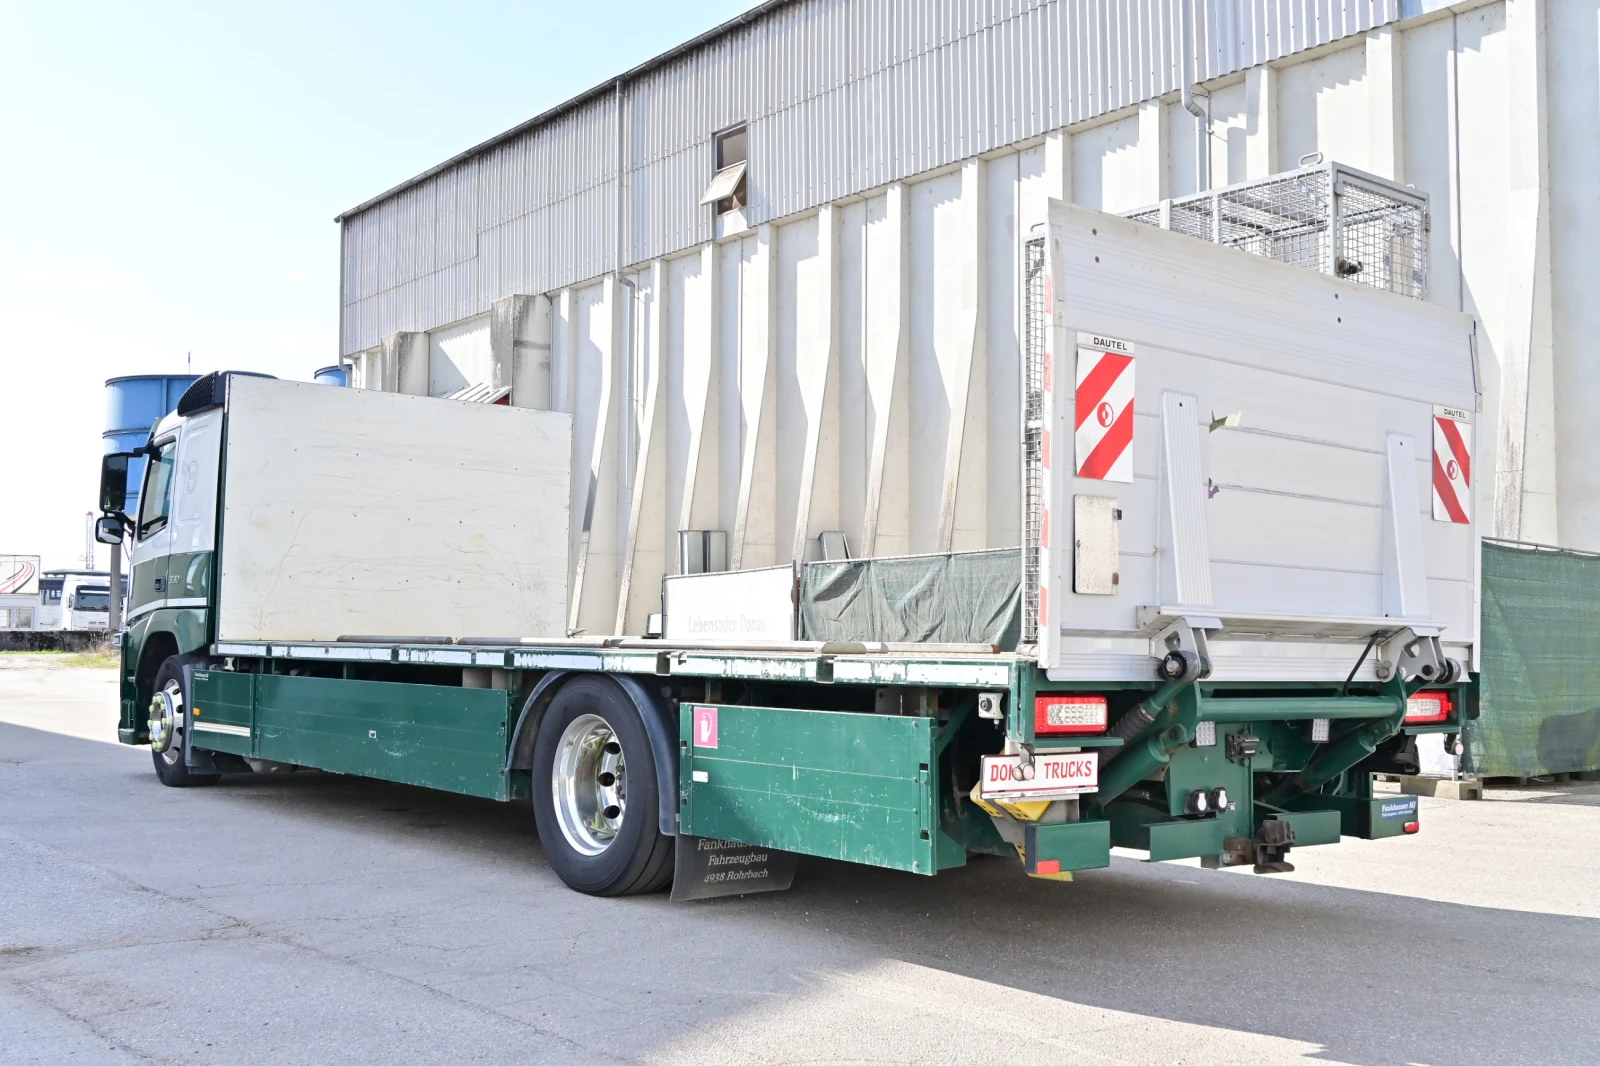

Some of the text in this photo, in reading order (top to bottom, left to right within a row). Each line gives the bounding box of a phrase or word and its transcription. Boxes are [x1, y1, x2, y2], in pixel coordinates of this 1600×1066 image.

[1093, 336, 1128, 351] DAUTEL
[1443, 408, 1466, 419] DAUTEL
[688, 614, 767, 633] Lebensader Donau
[1044, 760, 1092, 779] TRUCKS
[708, 852, 768, 866] Fahrzeugbau
[703, 868, 769, 884] 4938 Rohrbach
